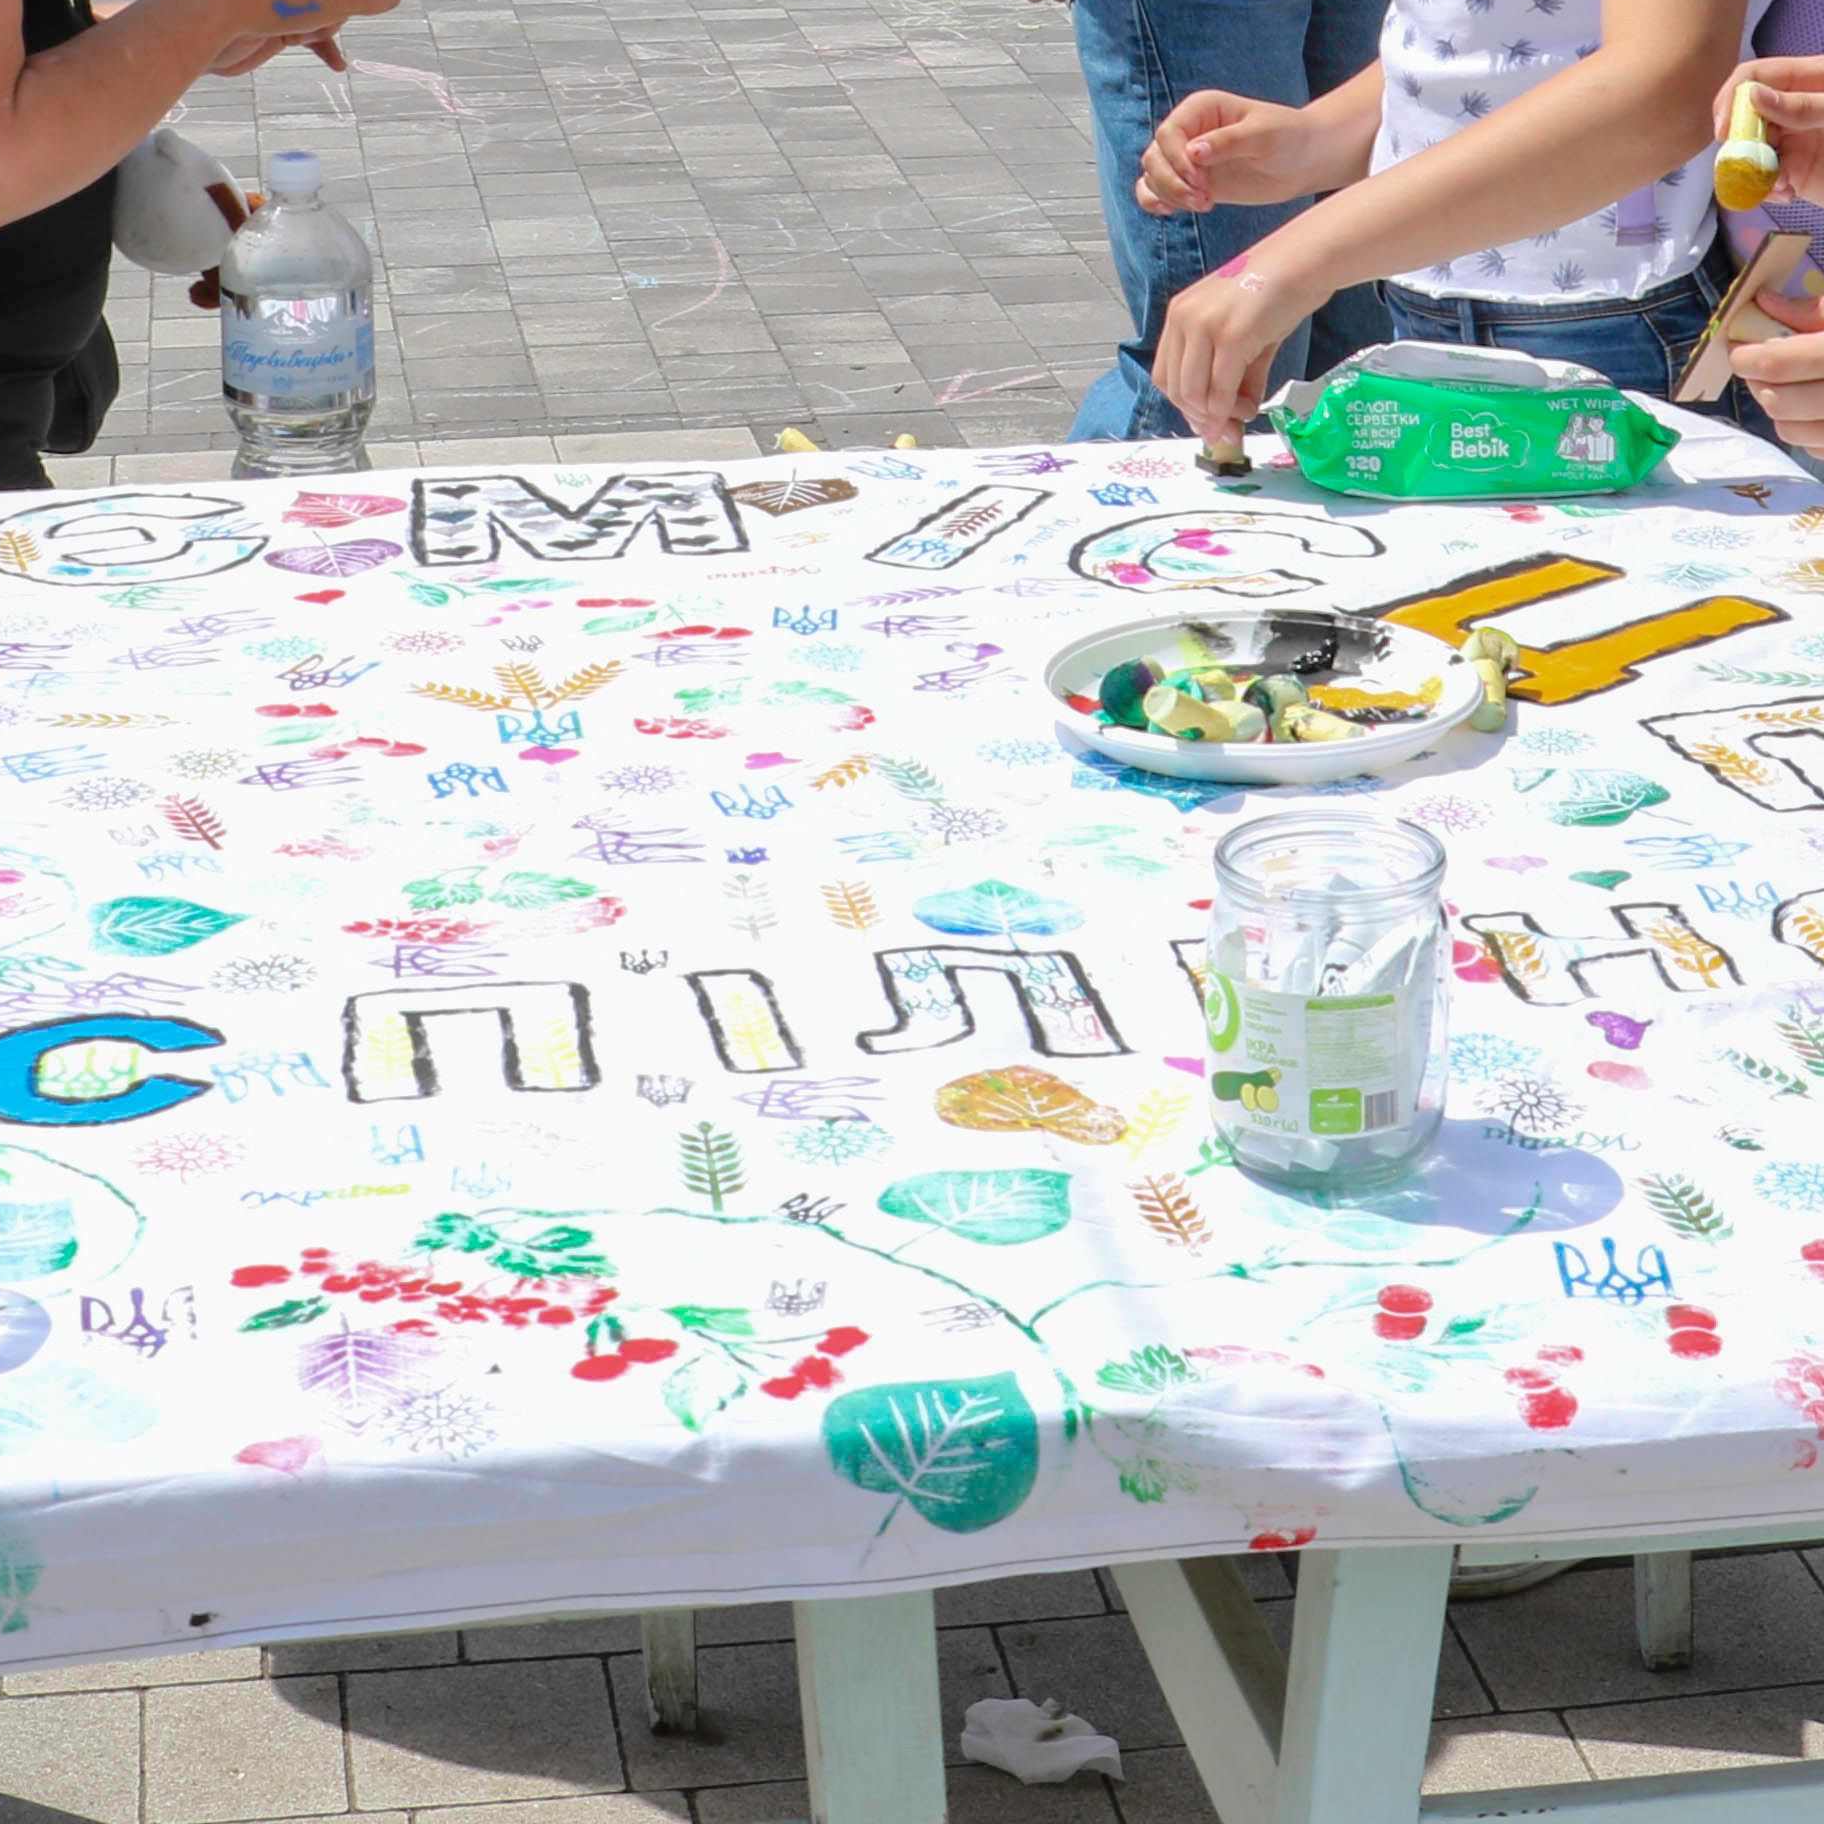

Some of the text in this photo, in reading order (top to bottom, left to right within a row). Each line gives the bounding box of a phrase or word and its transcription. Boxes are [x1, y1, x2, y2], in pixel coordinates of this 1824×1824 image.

[1546, 397, 1580, 412] WET
[1346, 413, 1421, 426] СЕРВЕТКИ
[1450, 421, 1492, 439] Best
[1450, 437, 1510, 459] Bebik
[1344, 455, 1383, 473] 120
